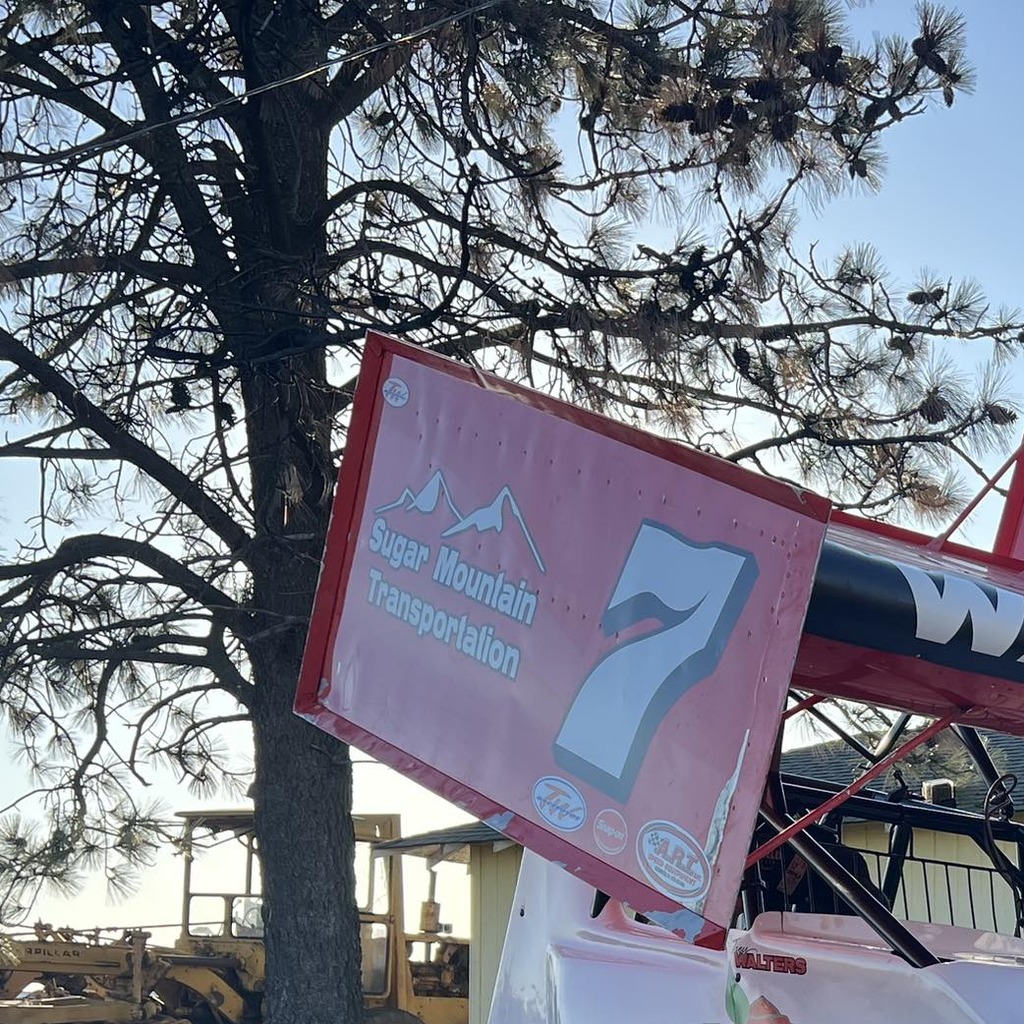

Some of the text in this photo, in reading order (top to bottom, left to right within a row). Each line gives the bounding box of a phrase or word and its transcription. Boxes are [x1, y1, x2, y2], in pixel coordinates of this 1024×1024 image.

[367, 567, 521, 681] Transportation
[369, 517, 539, 628] Sugar Mountain
[552, 518, 760, 805] 7
[734, 952, 807, 975] WALTERS
